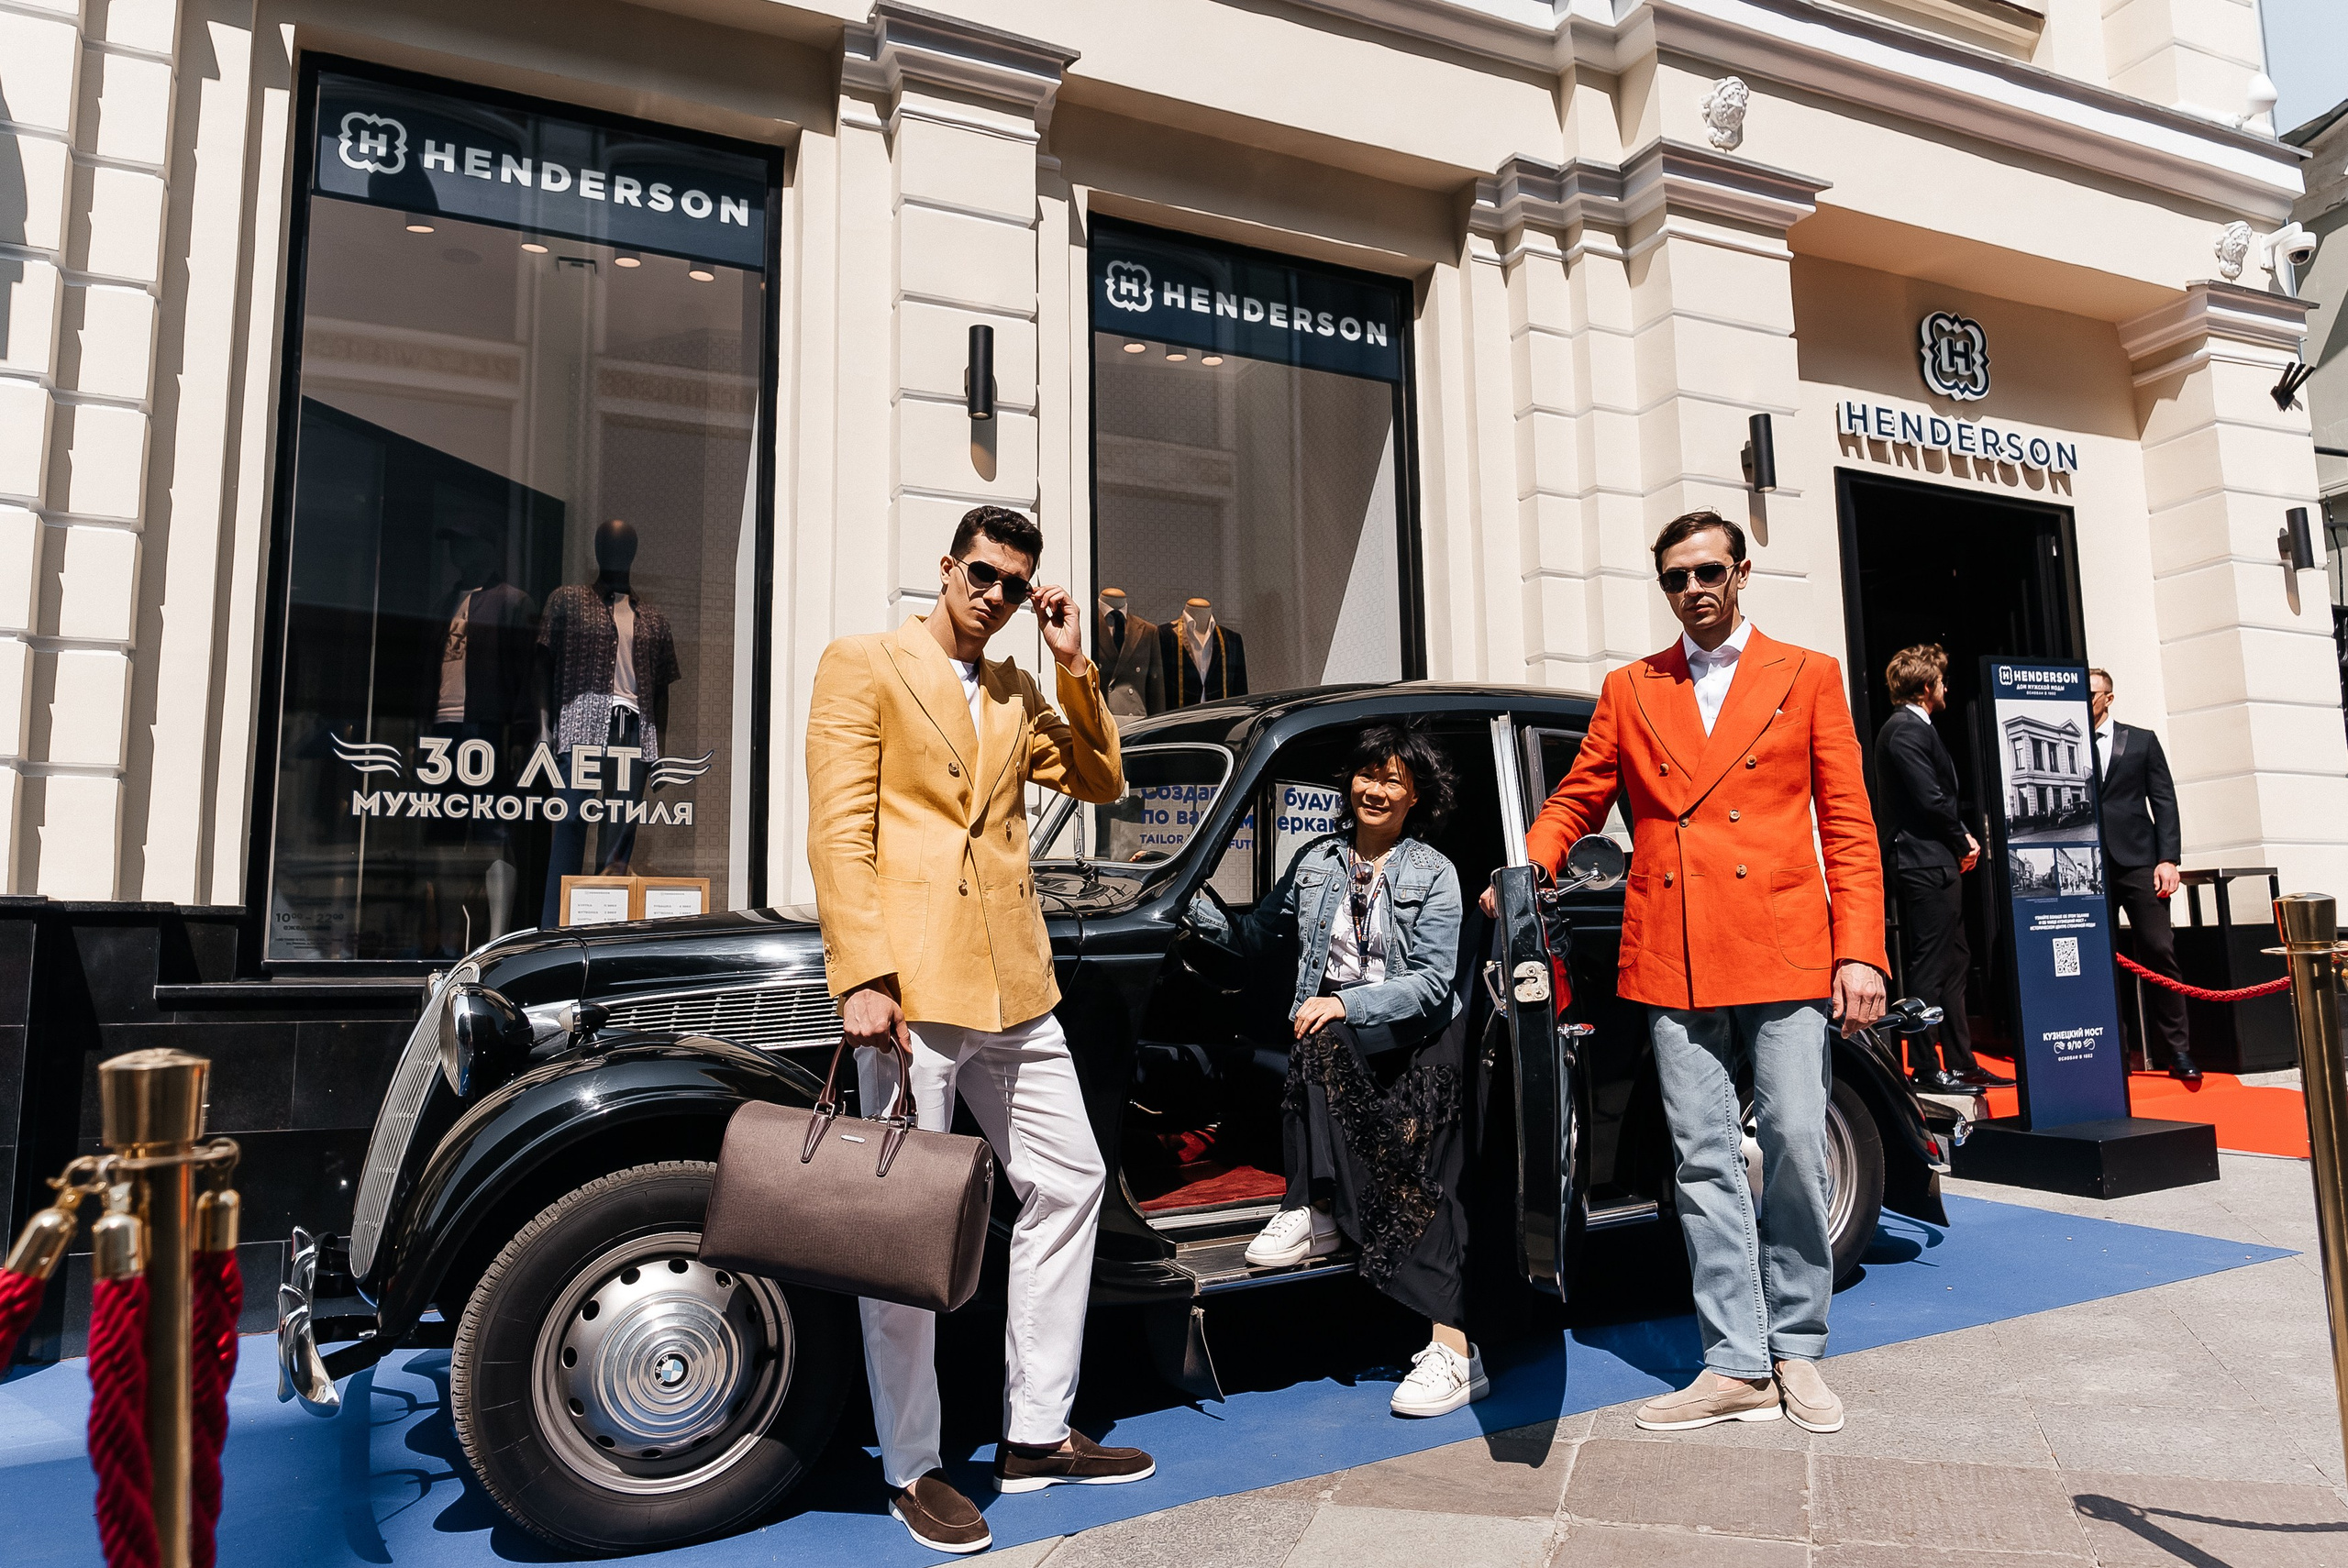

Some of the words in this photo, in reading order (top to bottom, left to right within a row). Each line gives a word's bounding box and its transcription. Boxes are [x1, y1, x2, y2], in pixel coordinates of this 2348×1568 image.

[359, 129, 387, 157] H
[423, 139, 749, 226] HENDERSON
[1119, 275, 1137, 298] H
[1163, 282, 1388, 347] HENDERSON
[1940, 337, 1972, 375] H
[1838, 401, 2078, 474] HENDERSON
[2013, 670, 2078, 684] HENDERSON
[416, 736, 495, 787] 30
[516, 741, 642, 792] ЛЕТ
[352, 790, 569, 822] МУЖСКОГО
[580, 798, 693, 826] СТИЛЯ
[1141, 810, 1169, 824] по
[1277, 815, 1336, 834] ерка
[1140, 834, 1183, 845] TAILOR
[1229, 839, 1254, 850] FUT
[2043, 1027, 2084, 1041] КУЗНЕЦКИЙ
[2084, 1027, 2104, 1037] МОСТ
[2066, 1040, 2082, 1051] 9/10
